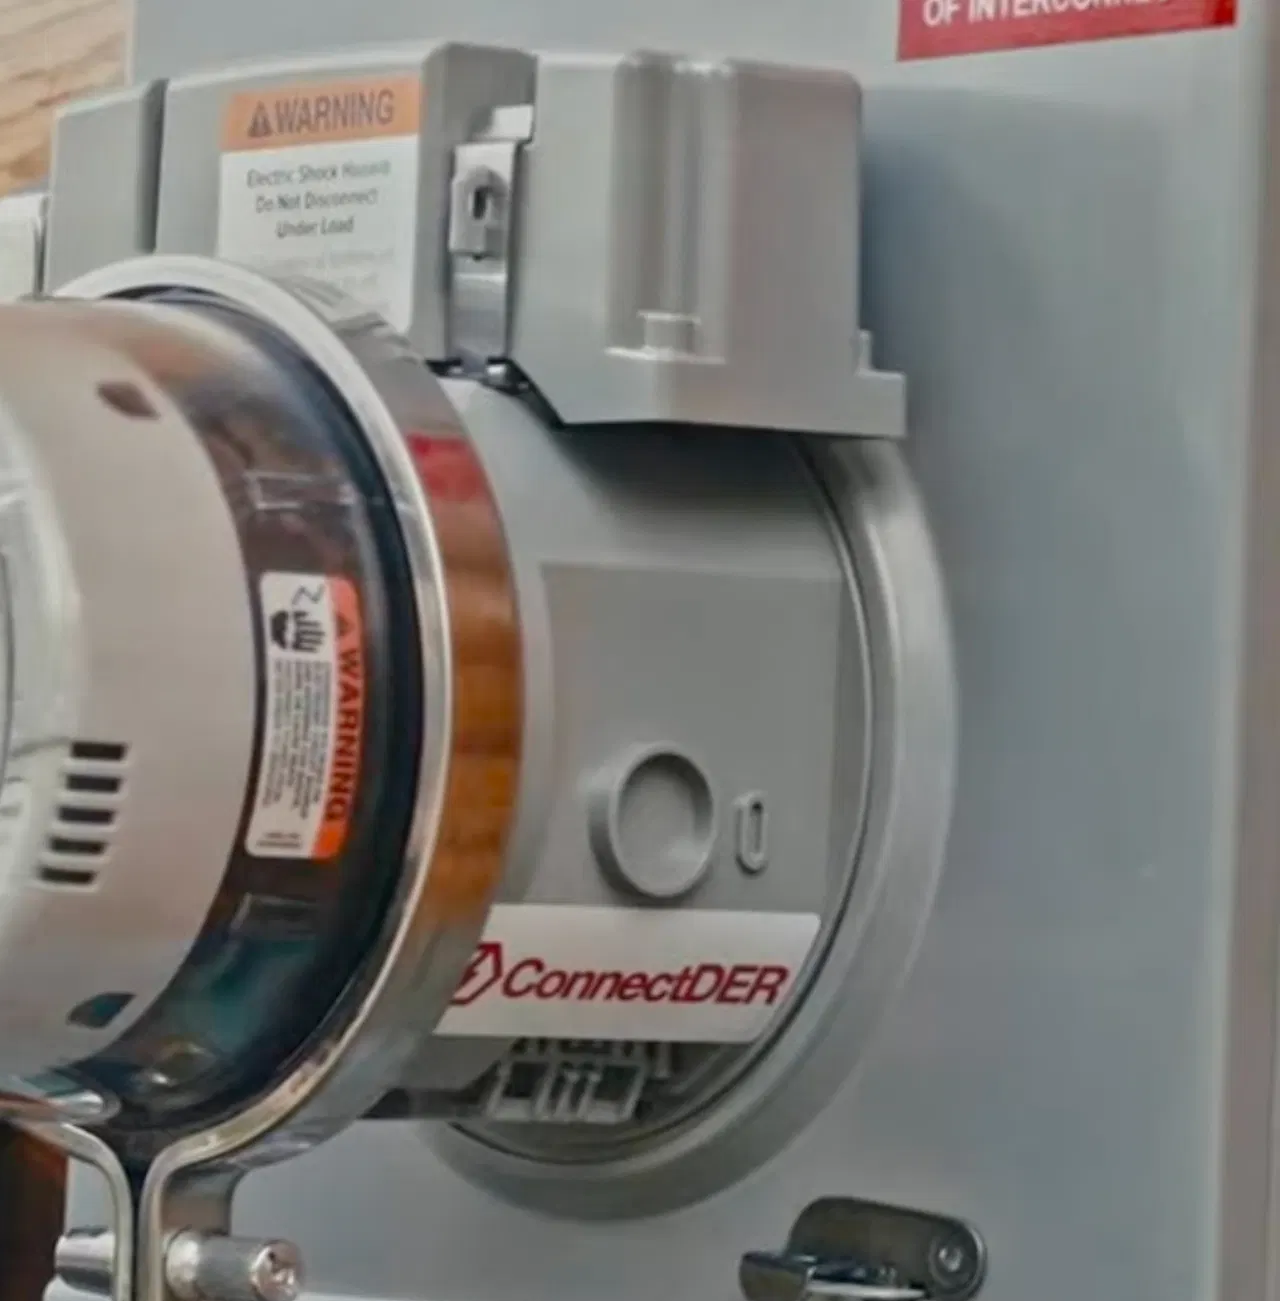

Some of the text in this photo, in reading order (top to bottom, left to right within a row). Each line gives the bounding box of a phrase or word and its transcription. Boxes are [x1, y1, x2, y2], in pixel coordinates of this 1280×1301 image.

[275, 89, 396, 135] WARNING
[324, 650, 361, 822] WARNING
[502, 957, 790, 1008] ConnectDER
